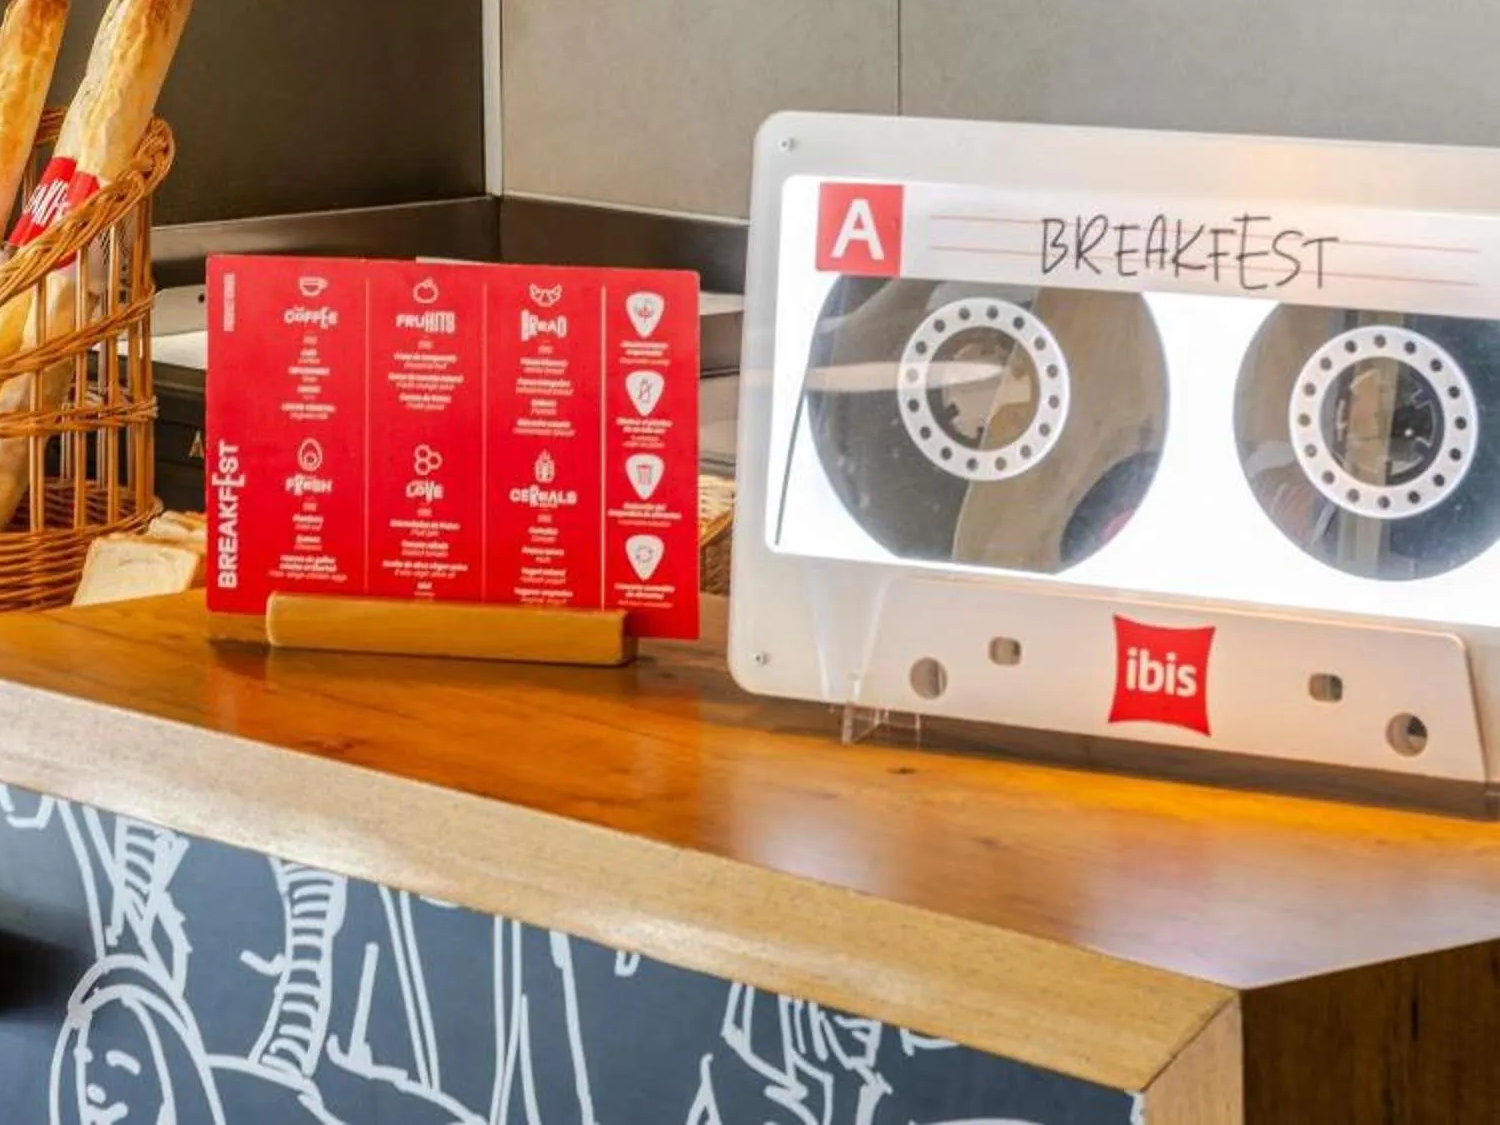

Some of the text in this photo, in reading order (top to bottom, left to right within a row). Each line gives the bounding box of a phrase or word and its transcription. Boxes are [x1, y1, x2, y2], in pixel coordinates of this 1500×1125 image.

[830, 197, 886, 261] A
[1040, 213, 1339, 290] BREAKFEST
[211, 439, 246, 589] BREAKFEST
[1124, 647, 1198, 698] ibis
